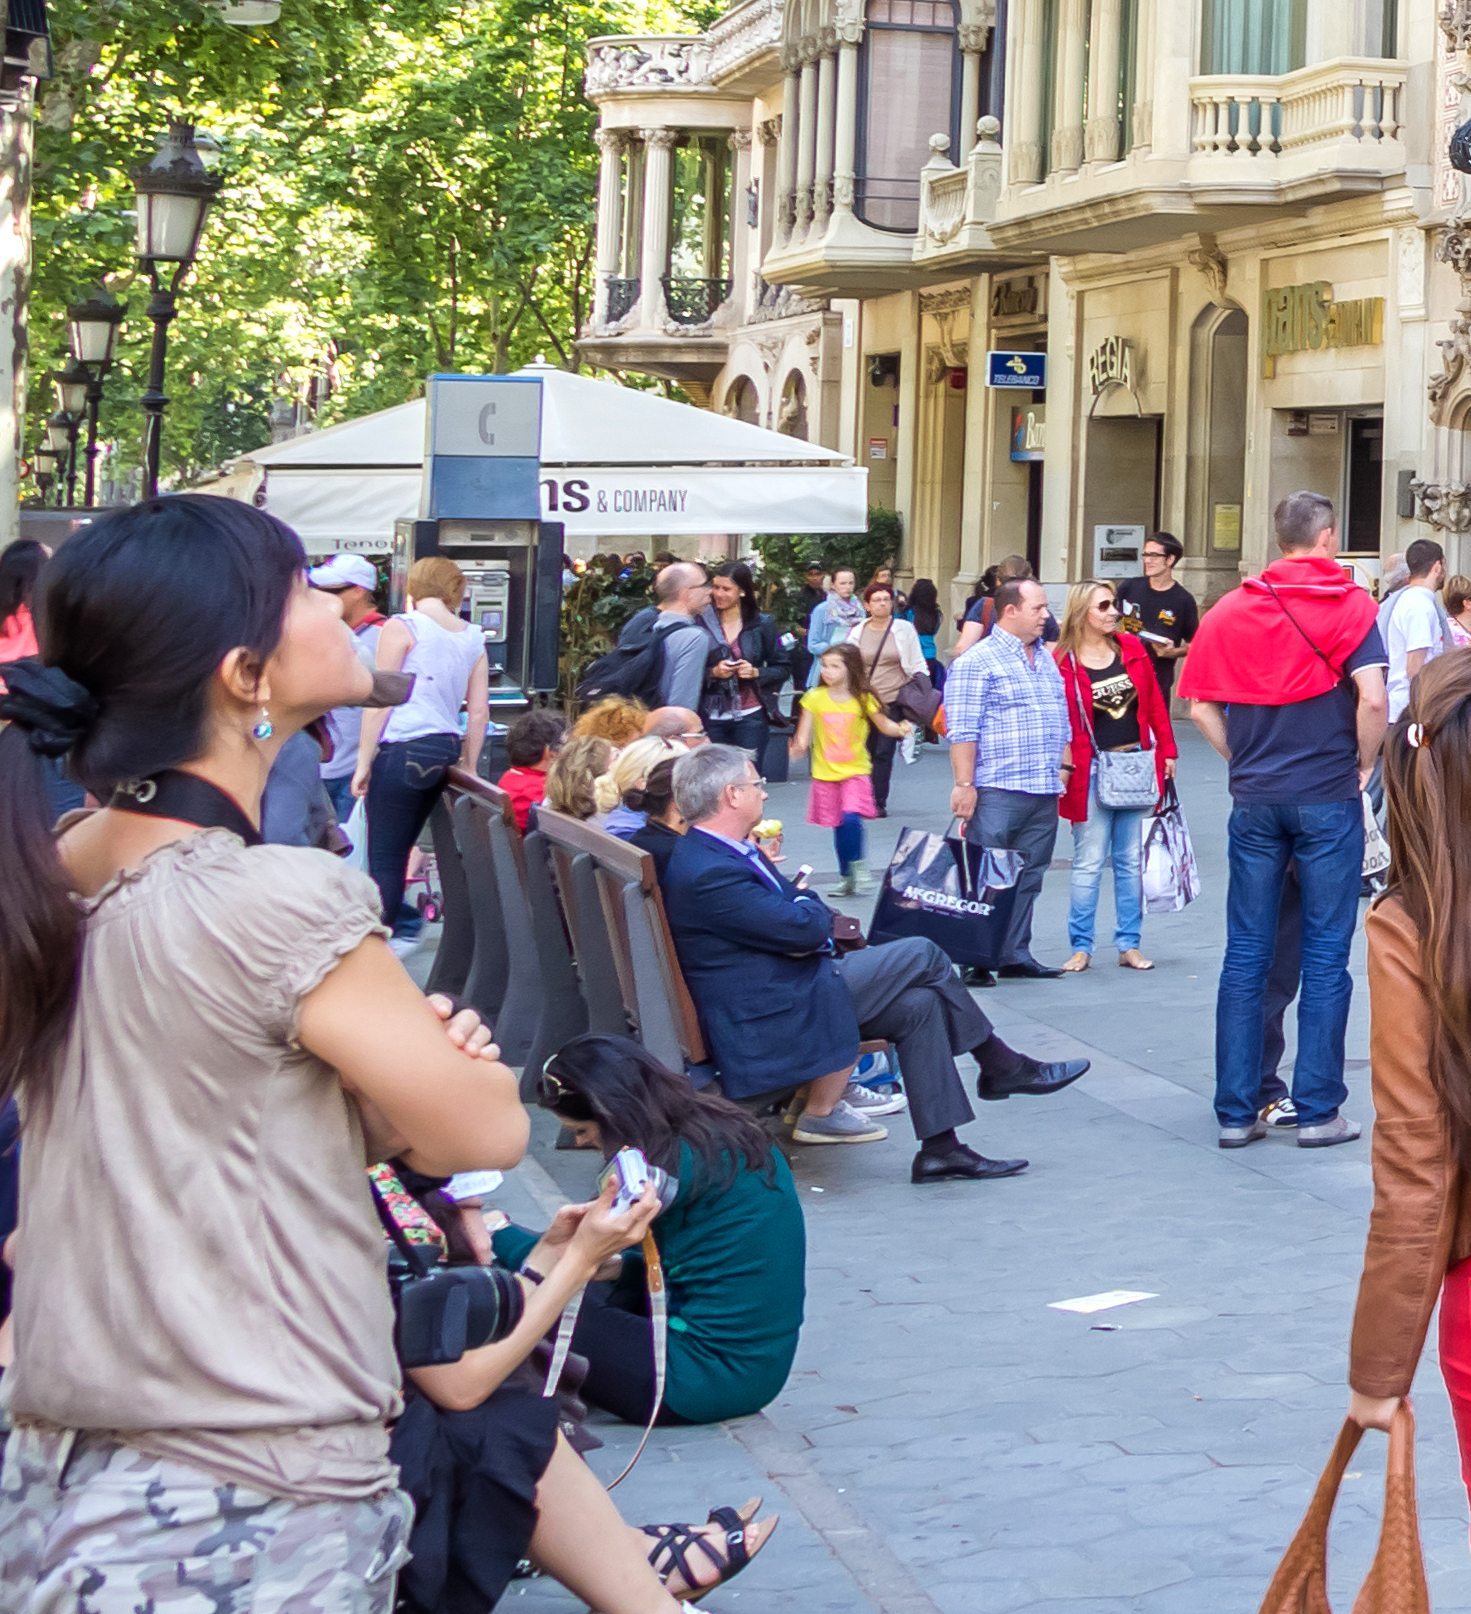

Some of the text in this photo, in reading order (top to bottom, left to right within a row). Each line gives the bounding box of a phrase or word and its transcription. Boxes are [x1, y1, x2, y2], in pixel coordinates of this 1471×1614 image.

[1089, 335, 1131, 396] REGIA
[597, 489, 608, 513] &
[613, 489, 688, 513] COMPANY
